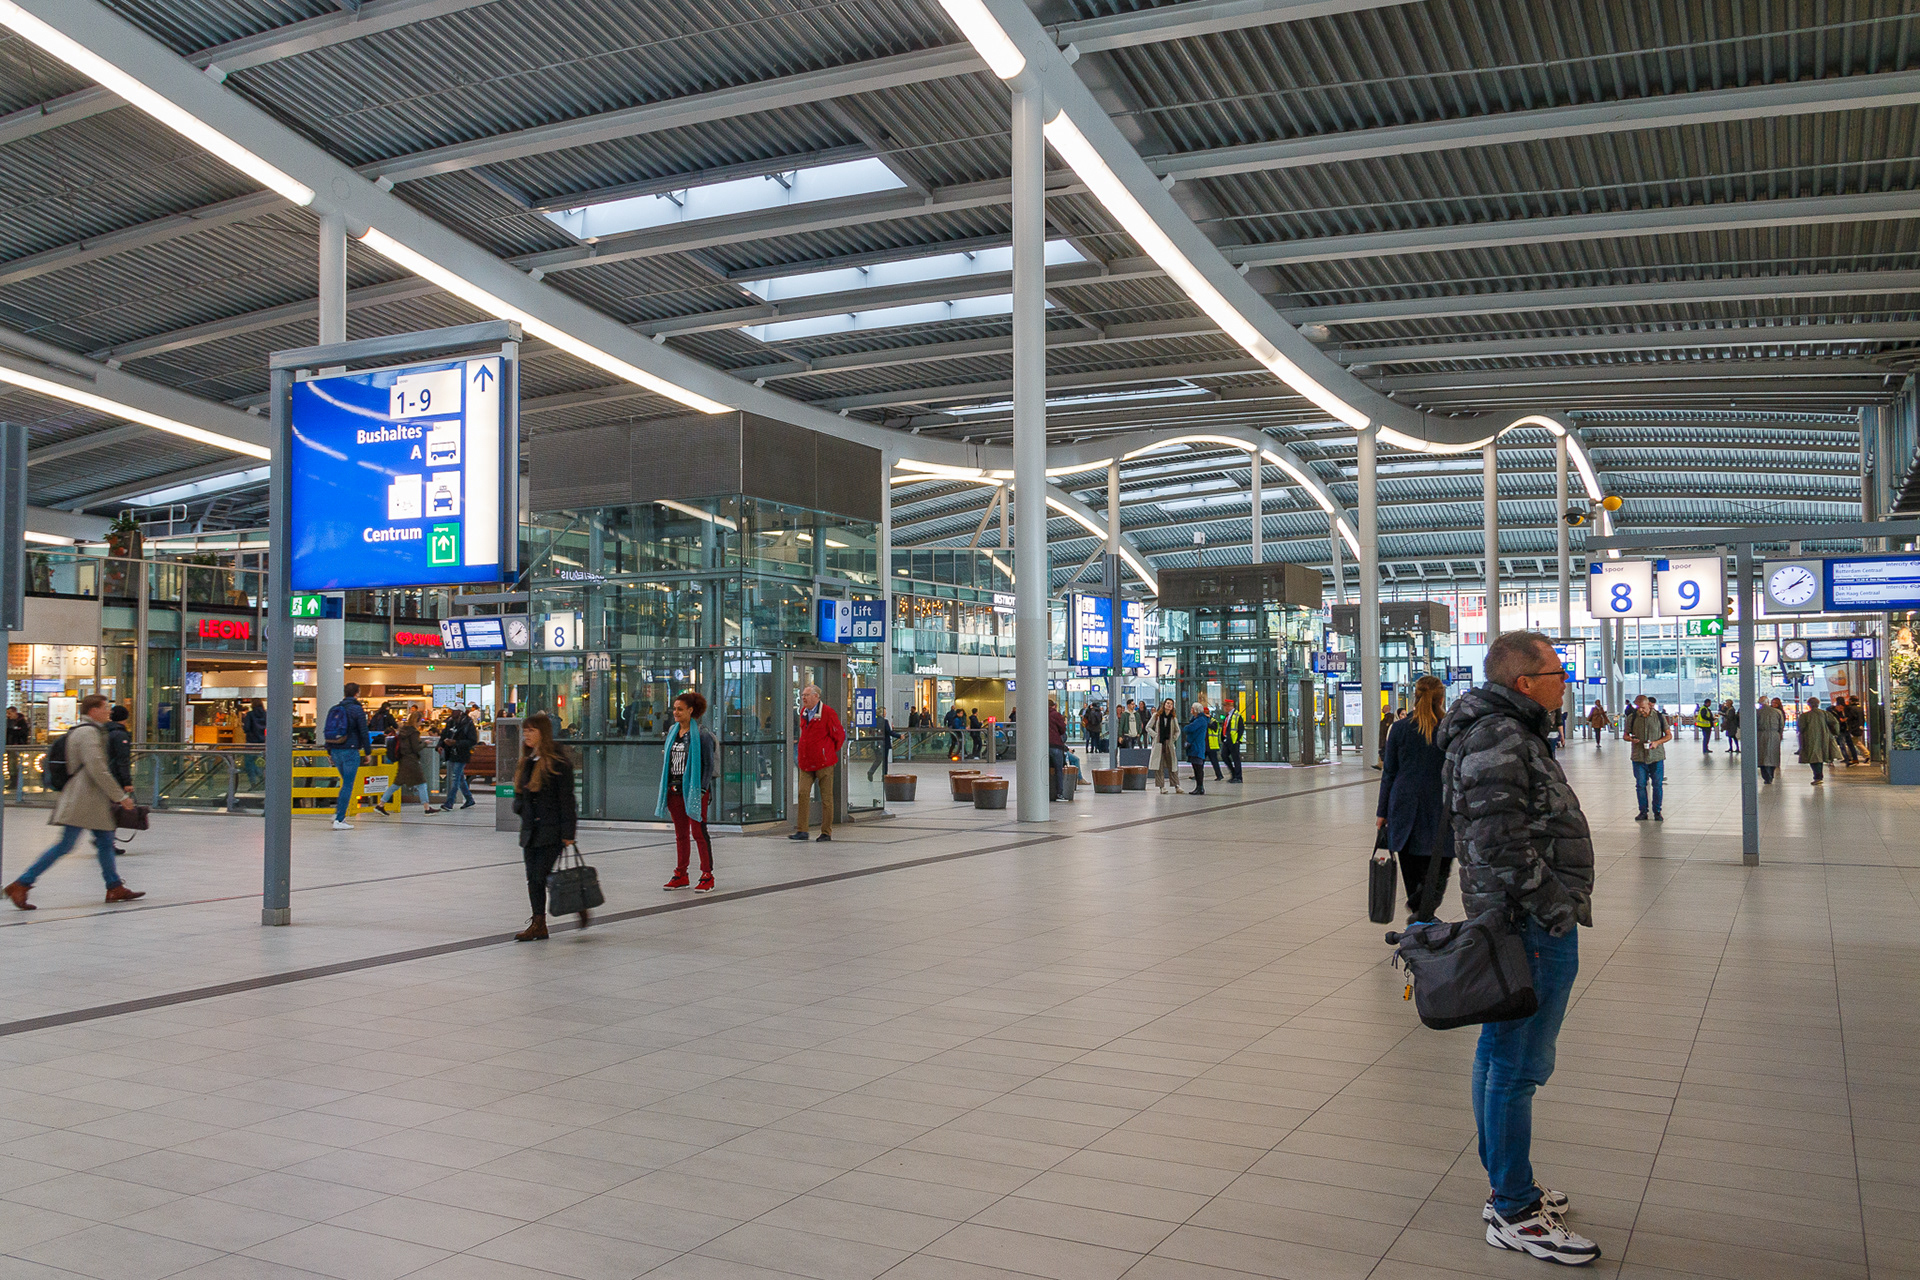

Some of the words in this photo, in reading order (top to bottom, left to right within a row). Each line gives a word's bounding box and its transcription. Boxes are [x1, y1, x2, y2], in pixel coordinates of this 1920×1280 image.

[396, 388, 431, 414] 1-9
[357, 425, 422, 444] Bushaltes
[410, 445, 422, 460] A
[363, 527, 422, 542] Centrum
[1610, 583, 1632, 613] 8
[1678, 580, 1700, 610] 9
[853, 605, 872, 617] Lift
[198, 619, 249, 639] LEON
[554, 626, 565, 647] 8
[857, 627, 863, 635] 8
[872, 627, 878, 636] 9
[412, 633, 443, 646] SWIRL
[1730, 651, 1740, 664] 5
[1759, 650, 1770, 663] 7
[914, 662, 943, 675] Leonidas
[1165, 664, 1172, 675] 7
